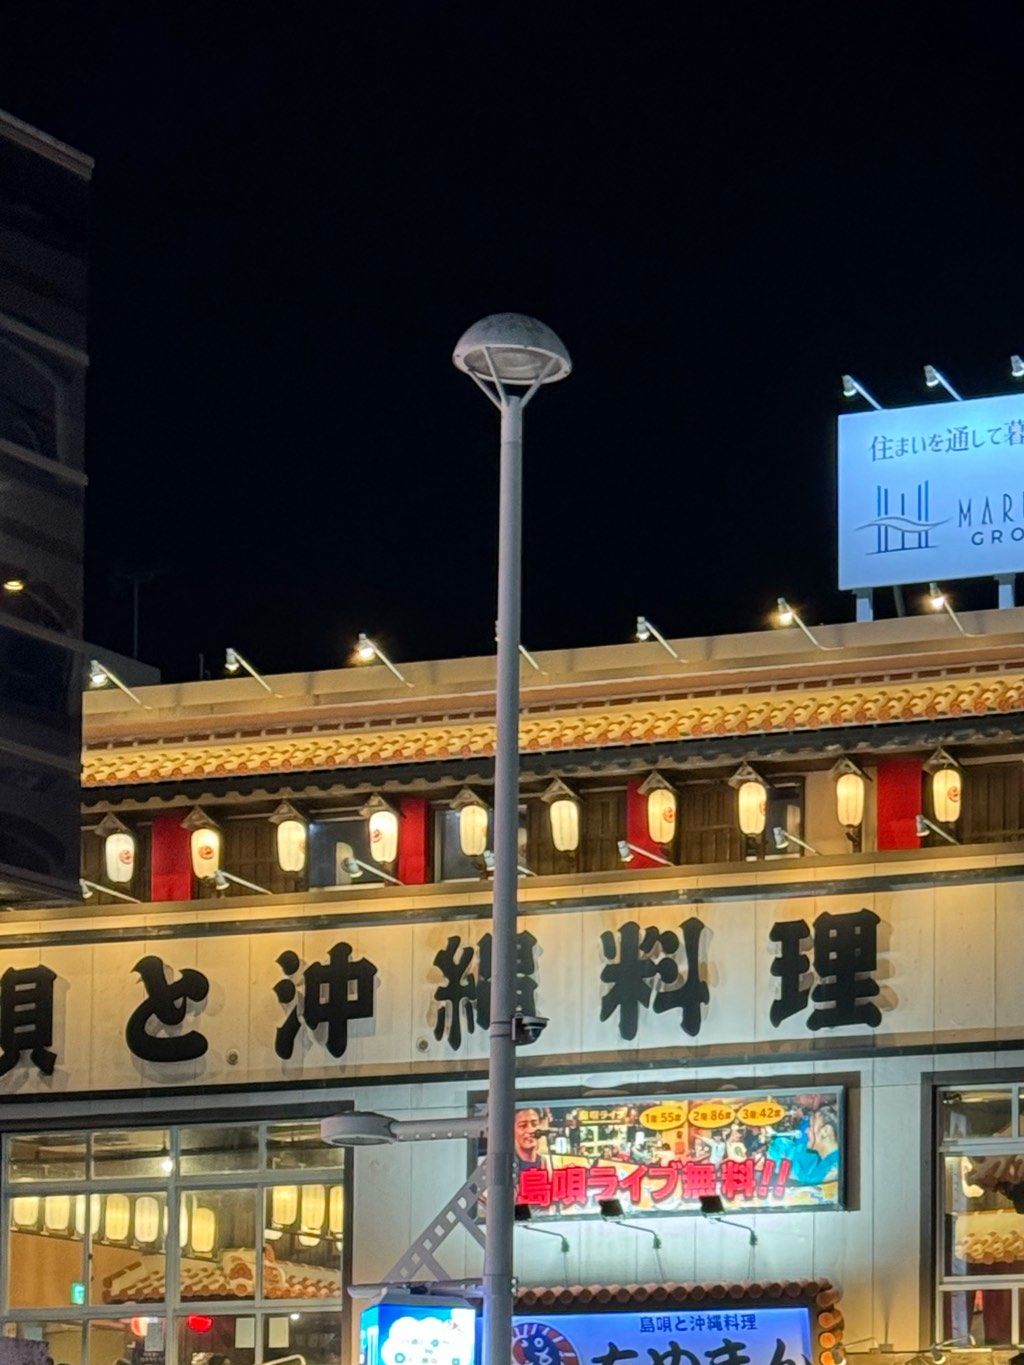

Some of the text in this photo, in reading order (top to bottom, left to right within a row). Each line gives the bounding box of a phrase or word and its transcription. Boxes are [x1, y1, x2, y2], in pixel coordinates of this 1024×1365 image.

[639, 1314, 758, 1333] 島唄と沖縄料理
